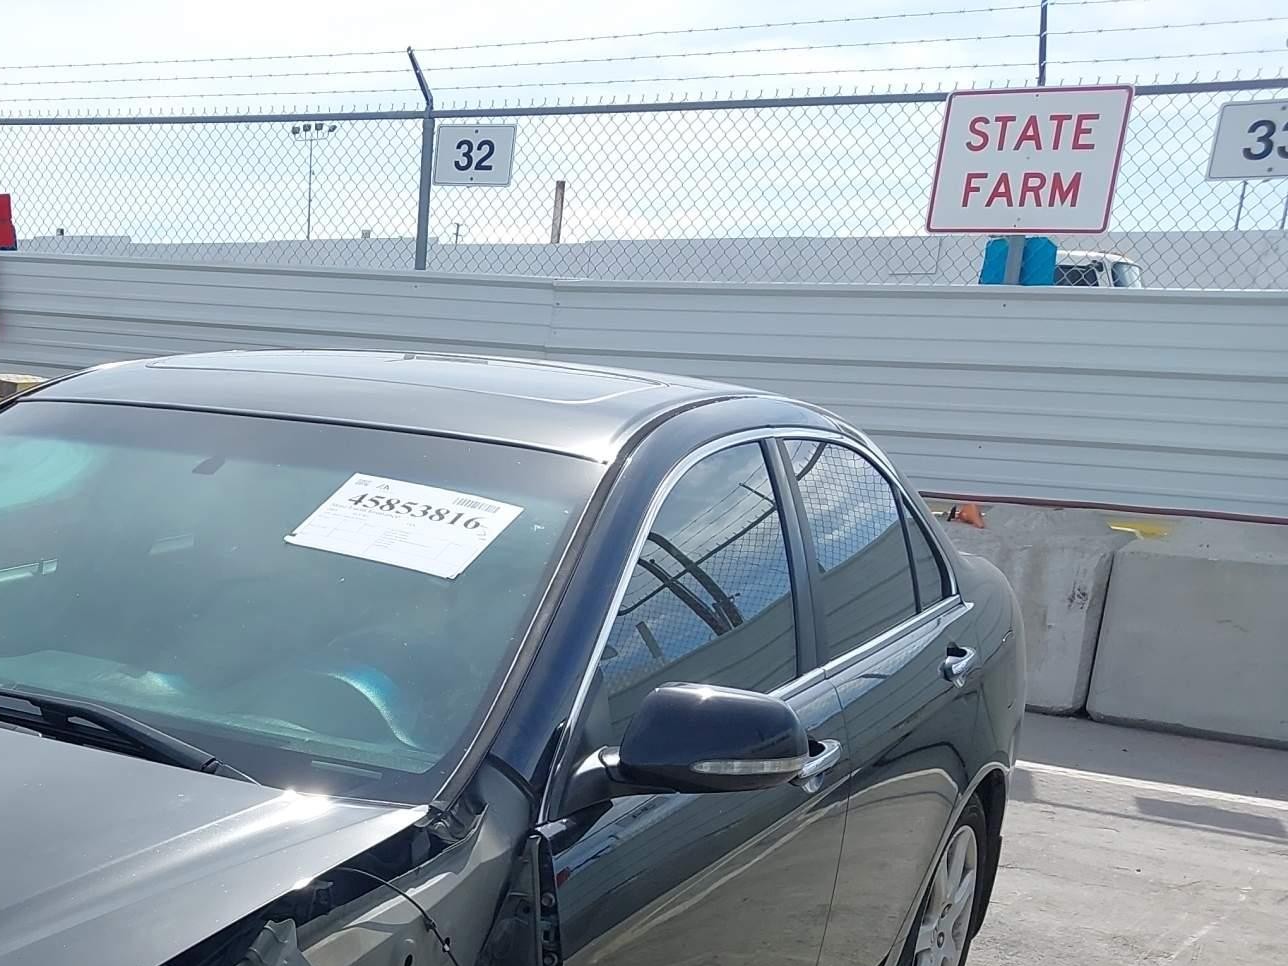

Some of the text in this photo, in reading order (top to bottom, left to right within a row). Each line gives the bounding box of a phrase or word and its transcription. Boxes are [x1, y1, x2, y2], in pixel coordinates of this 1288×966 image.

[965, 113, 1100, 152] STATE
[454, 139, 495, 171] 32
[961, 171, 1082, 208] FARM
[347, 492, 482, 530] 45853816
